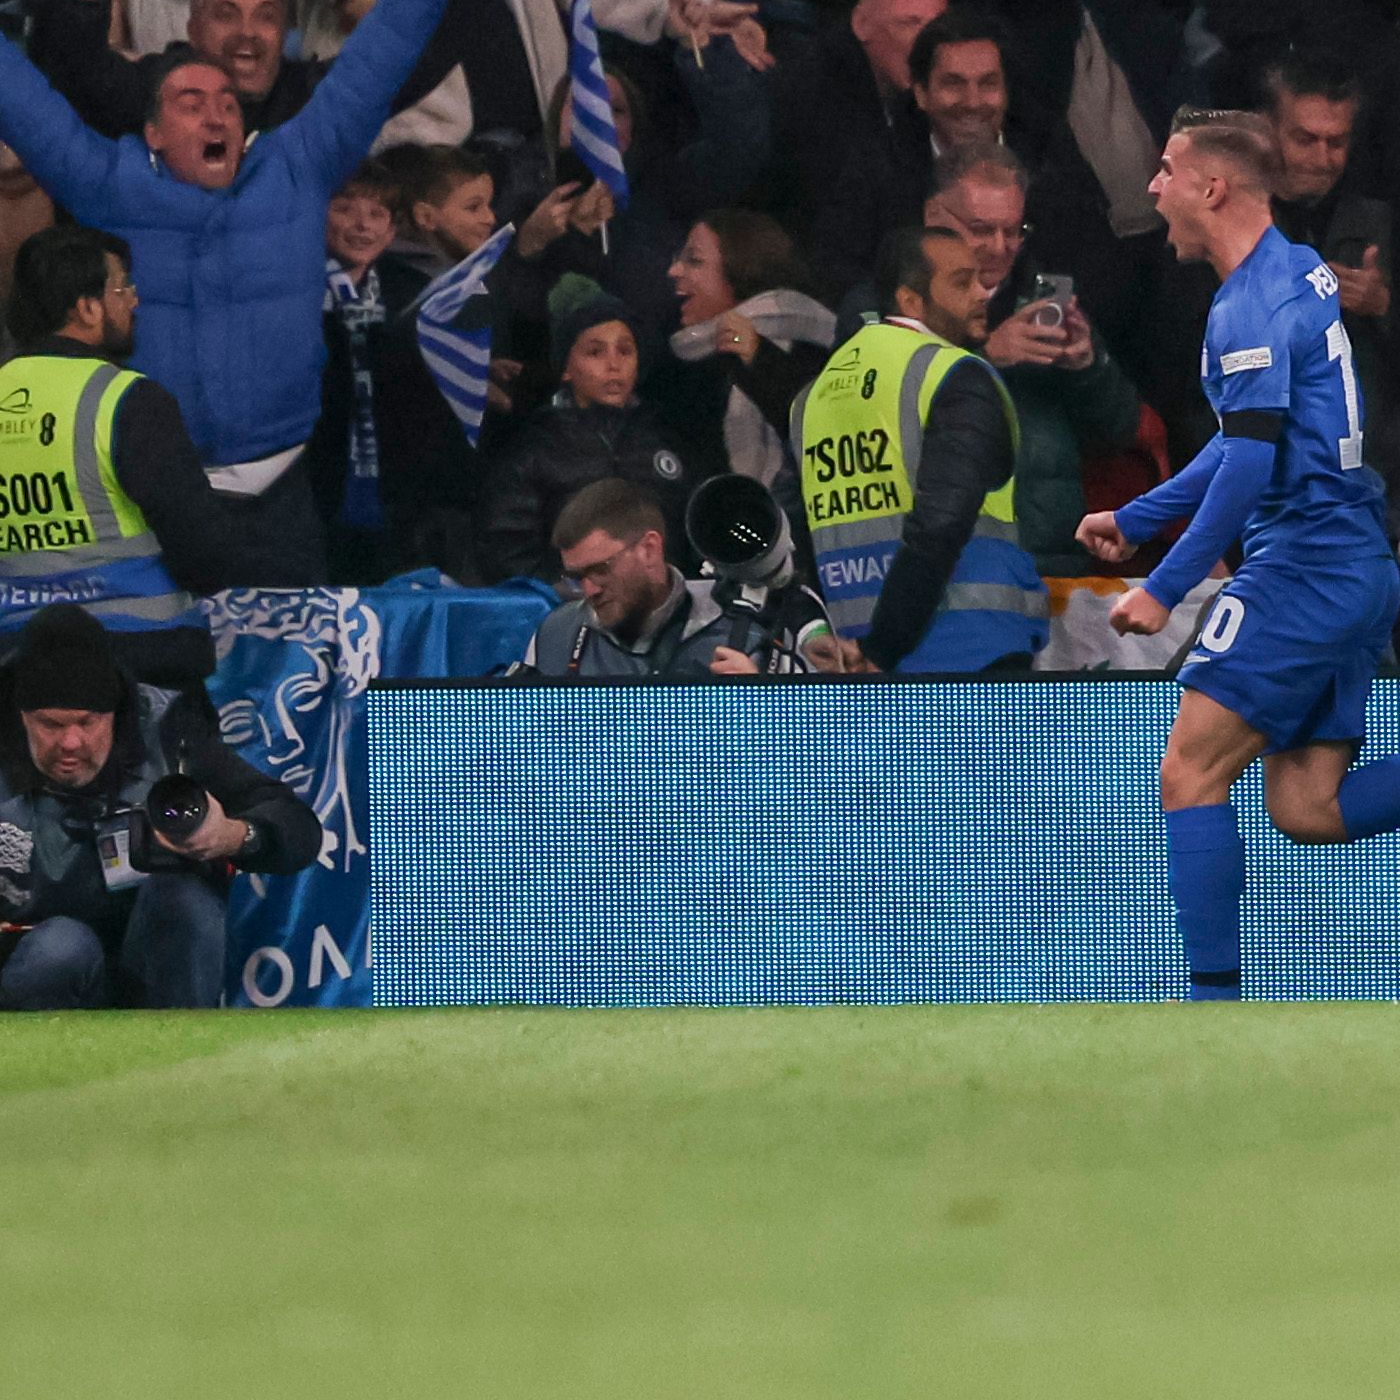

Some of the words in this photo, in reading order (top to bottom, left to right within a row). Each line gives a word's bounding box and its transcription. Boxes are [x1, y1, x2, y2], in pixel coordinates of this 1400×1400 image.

[809, 481, 900, 522] EARCH
[0, 519, 91, 552] ARCH
[819, 555, 893, 588] EWA
[1201, 595, 1245, 653] 0
